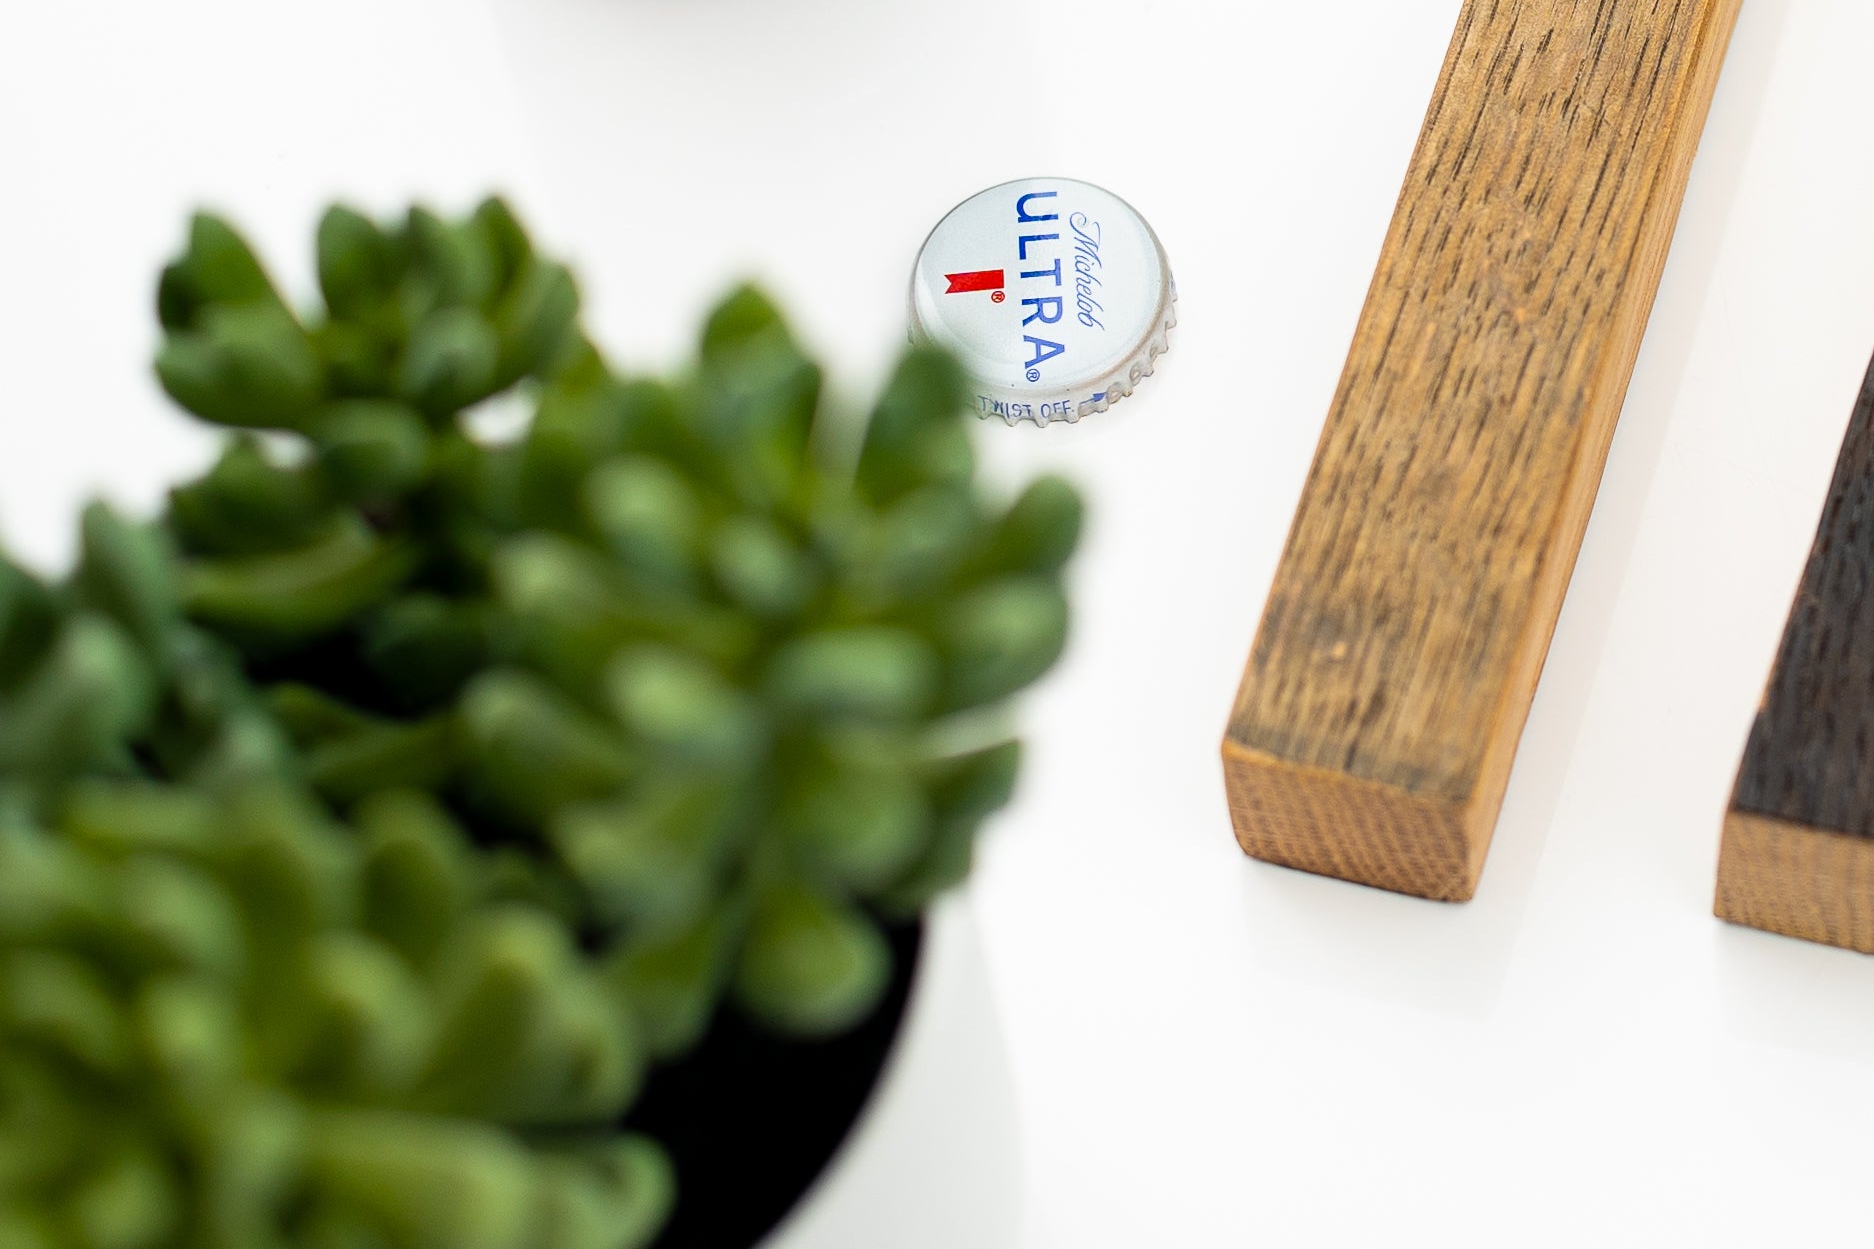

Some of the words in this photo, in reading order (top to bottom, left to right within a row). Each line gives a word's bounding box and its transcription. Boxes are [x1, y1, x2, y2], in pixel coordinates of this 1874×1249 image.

[1016, 191, 1066, 369] ULTRA
[1068, 211, 1106, 331] Michelob
[977, 395, 1032, 419] TWIST
